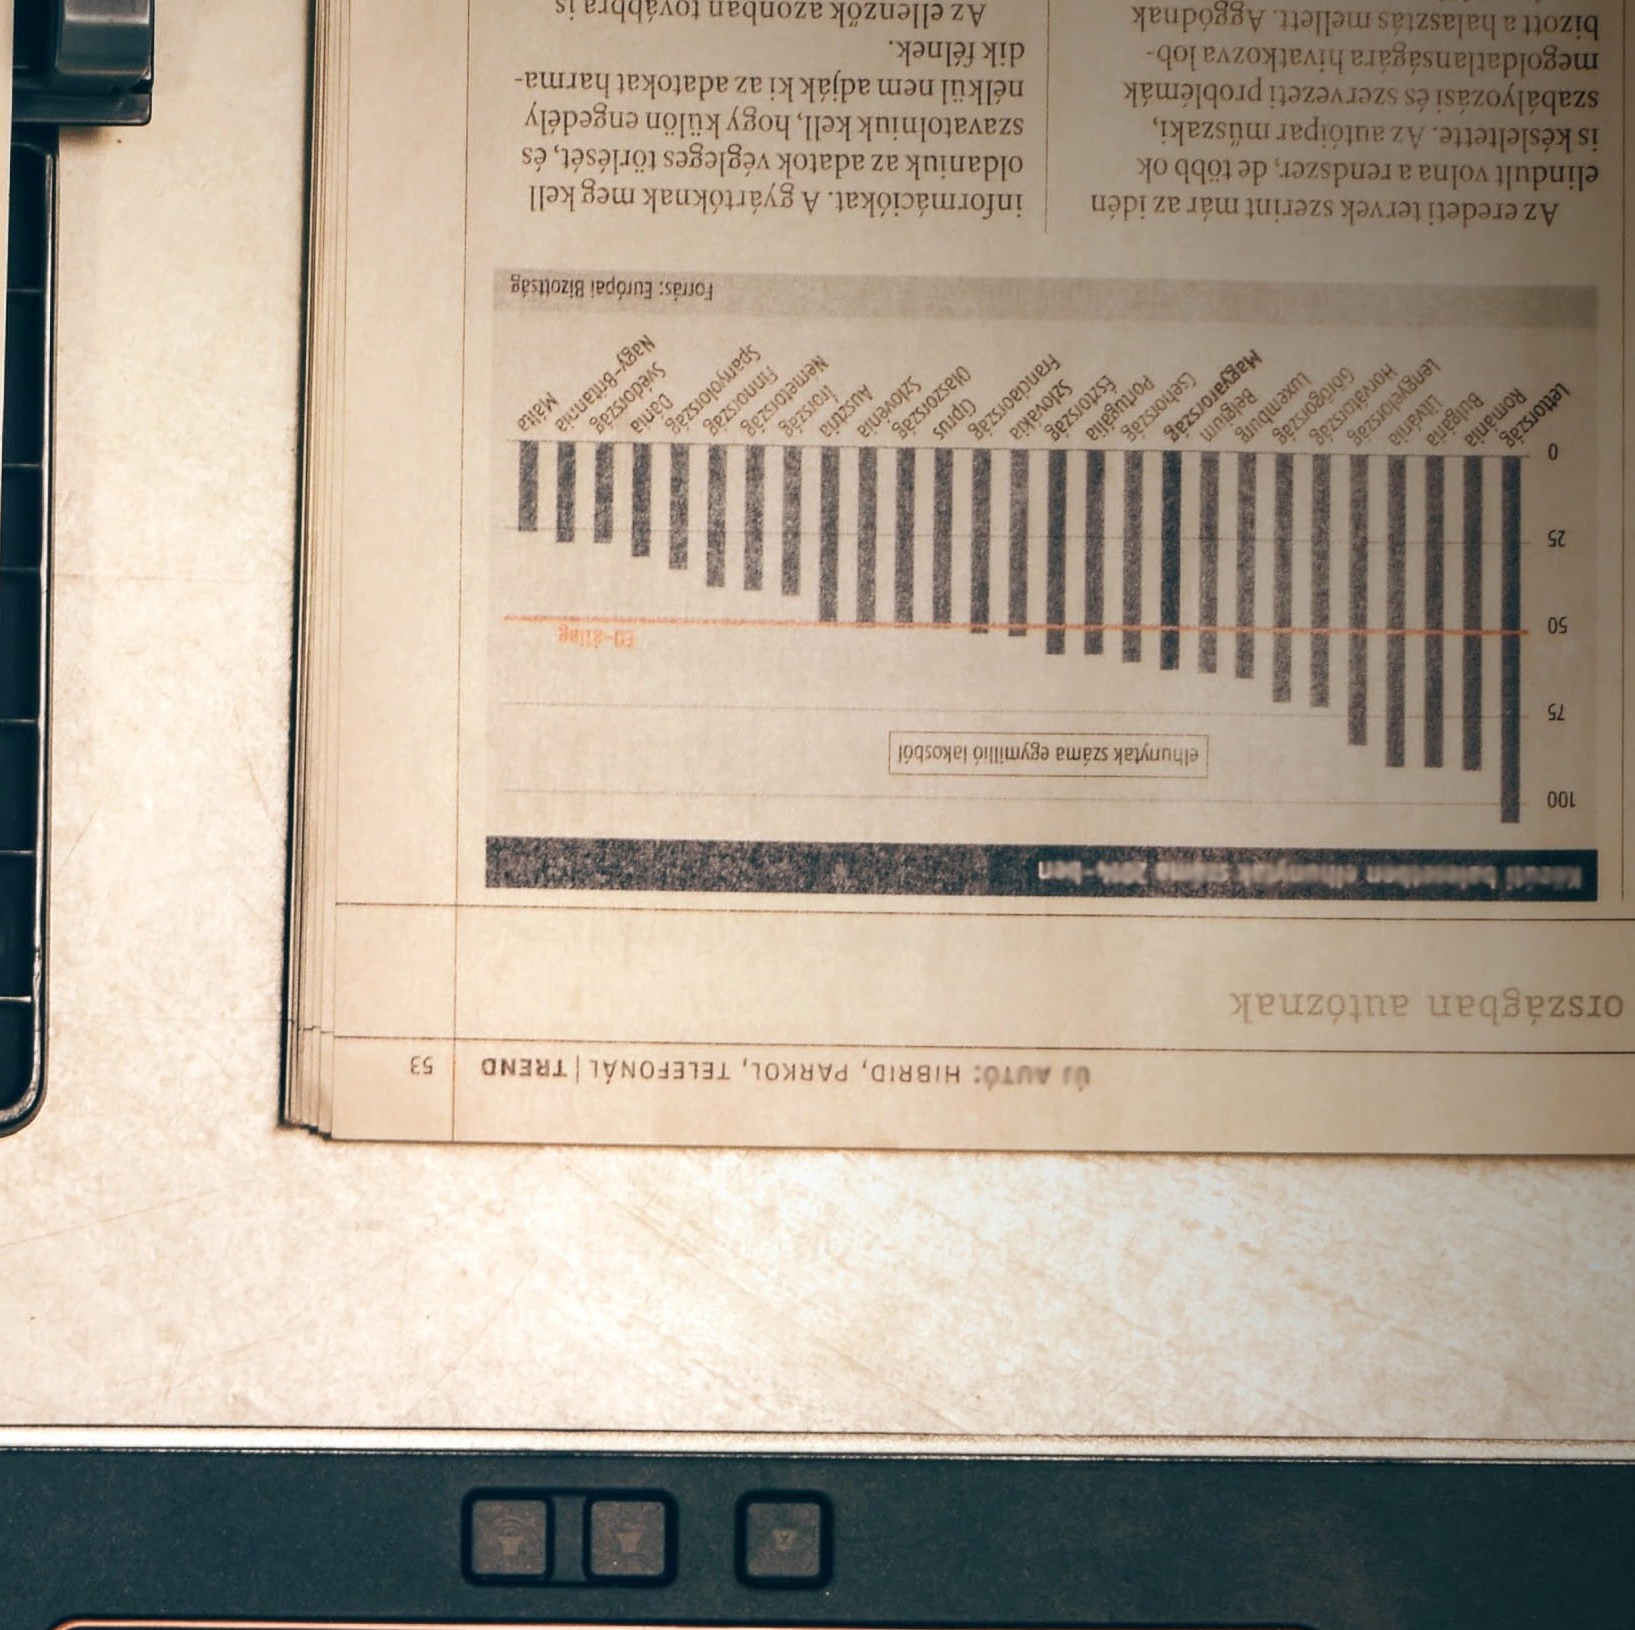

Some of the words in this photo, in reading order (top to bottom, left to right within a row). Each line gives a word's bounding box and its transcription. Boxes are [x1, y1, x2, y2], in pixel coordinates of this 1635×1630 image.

[585, 0, 699, 23] továbbra
[710, 0, 822, 26] azonban
[831, 3, 943, 29] ellenzők
[951, 4, 986, 27] Az
[1132, 0, 1265, 33] Aggódnak
[1274, 10, 1371, 37] mellett.
[1503, 15, 1516, 32] a
[1378, 12, 1496, 40] halasztás
[1525, 15, 1599, 41] bizott
[889, 40, 974, 67] félnek.
[982, 42, 1025, 68] dik
[1146, 45, 1196, 71] lob-
[1203, 46, 1343, 74] hivatkozva
[1351, 42, 1598, 78] megoldatlanságára
[515, 72, 609, 98] harma-
[617, 73, 728, 101] adatokat
[735, 76, 762, 93] az
[770, 77, 794, 103] ki
[800, 70, 870, 103] adják
[877, 79, 934, 96] nem
[942, 80, 1023, 106] nélkül
[1124, 77, 1261, 109] problémák
[1270, 85, 1397, 109] szervezeti
[1405, 88, 1429, 112] és
[1437, 83, 1599, 116] szabályozási
[525, 101, 638, 136] engedély
[647, 112, 719, 139] külön
[726, 106, 789, 140] hogy
[797, 113, 850, 142] kell,
[858, 116, 1023, 143] szavatolniuk
[1153, 117, 1269, 146] műszaki,
[1276, 116, 1384, 149] autóipar
[1391, 126, 1425, 150] Az
[1432, 127, 1571, 154] késleltette.
[1578, 128, 1598, 152] is
[522, 147, 546, 172] és
[554, 144, 655, 175] törlését,
[664, 143, 770, 177] végleges
[778, 153, 864, 179] adatok
[872, 154, 898, 171] az
[906, 155, 1023, 181] oldaniuk
[1137, 158, 1167, 184] ok
[1175, 159, 1230, 185] több
[1399, 164, 1411, 181] a
[1238, 160, 1267, 186] de
[1275, 159, 1391, 188] rendszer,
[1418, 164, 1488, 190] volna
[1496, 165, 1599, 192] elindult
[531, 185, 575, 212] kell
[582, 178, 634, 205] meg
[642, 183, 794, 215] gyártóknak
[801, 192, 820, 215] A
[1153, 196, 1180, 213] az
[829, 192, 1022, 220] információkat.
[1091, 195, 1146, 221] idén
[1187, 197, 1238, 221] már
[1246, 198, 1333, 223] szerint
[1340, 200, 1420, 226] tervek
[1429, 202, 1517, 228] eredeti
[1524, 203, 1559, 227] Az
[510, 274, 584, 298] Bizottság
[591, 276, 652, 300] Európai
[659, 281, 713, 301] Forrás:
[1548, 529, 1565, 547] 25
[1548, 616, 1567, 634] 50
[1548, 703, 1565, 721] 75
[899, 745, 967, 764] lakosból
[973, 742, 1049, 765] egymillió
[1056, 747, 1108, 766] száma
[1114, 743, 1198, 767] elhunytak
[1547, 791, 1576, 808] 100
[1229, 993, 1409, 1024] autóznak
[1428, 987, 1623, 1026] országban
[410, 1056, 433, 1075] 53
[482, 1058, 567, 1077] TREND
[590, 1060, 730, 1084] TELEFONÁL
[743, 1058, 847, 1082] PARKOL,
[862, 1060, 960, 1083] HIBRID,
